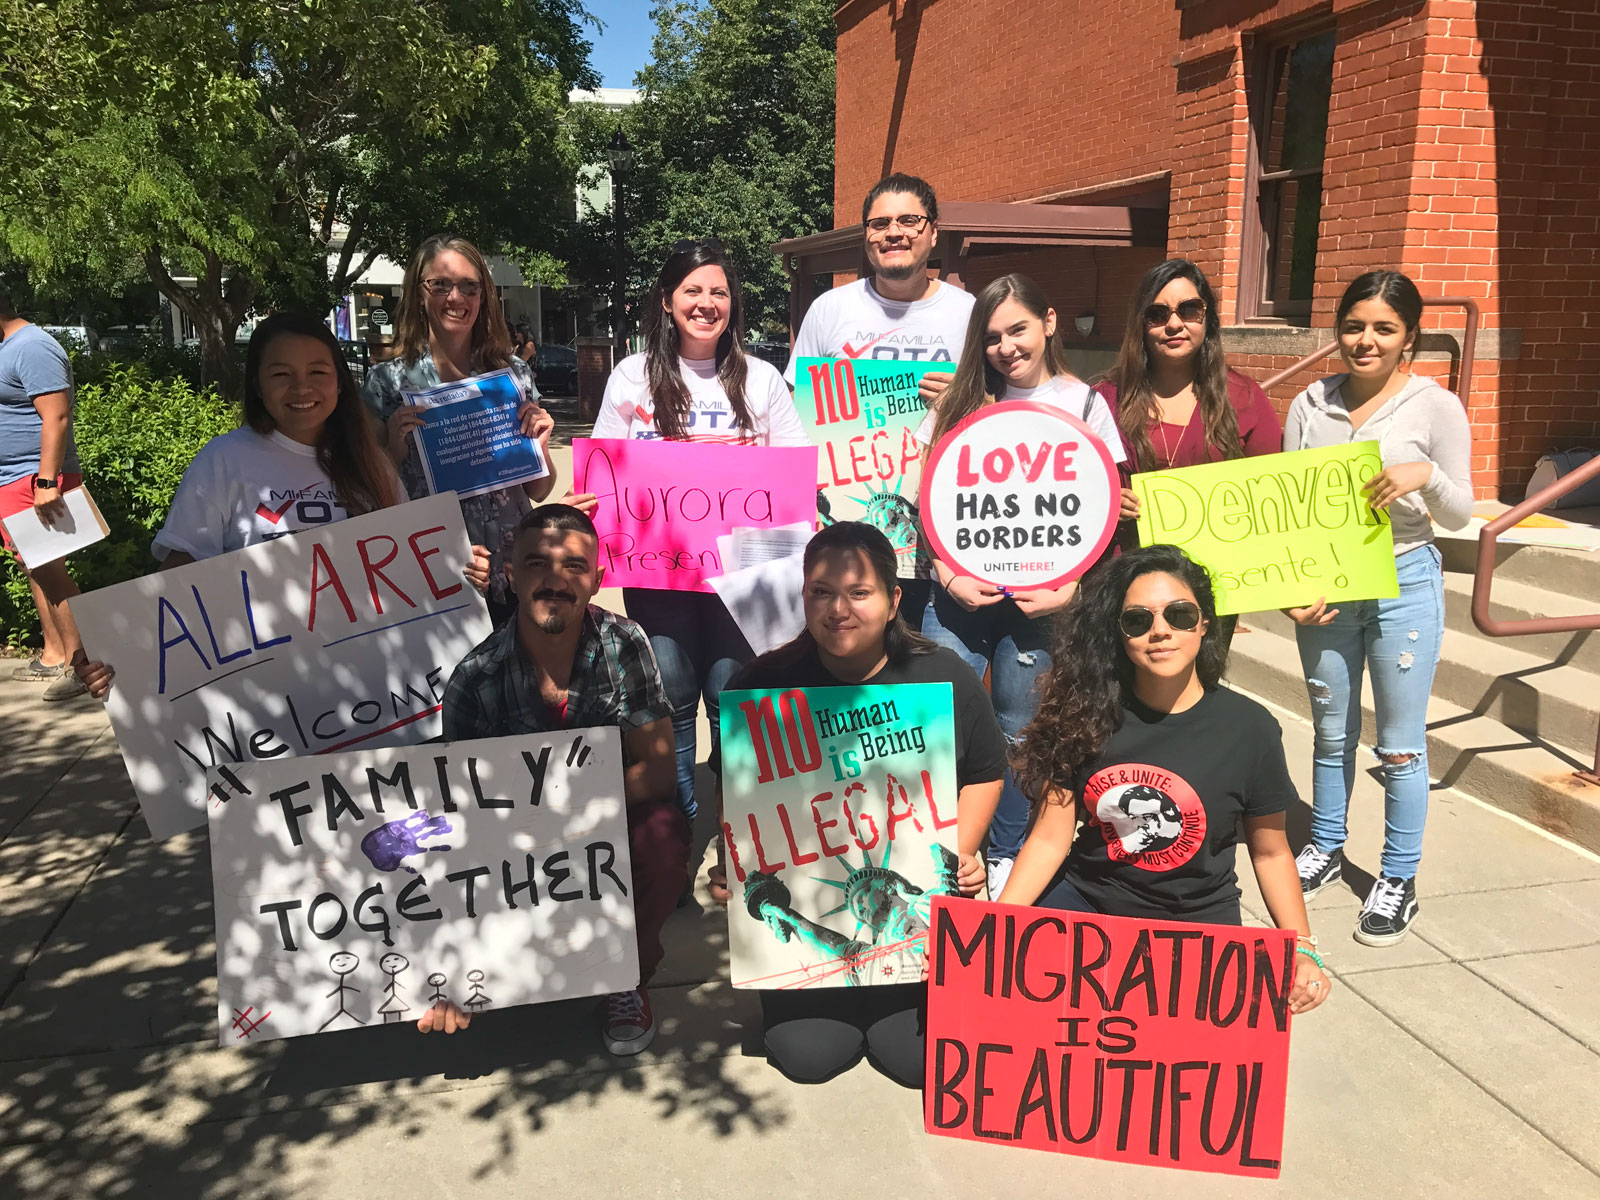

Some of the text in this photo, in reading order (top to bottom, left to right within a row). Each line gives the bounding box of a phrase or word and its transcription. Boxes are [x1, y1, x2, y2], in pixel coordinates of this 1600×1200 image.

[856, 331, 945, 346] MI FAMILIA
[440, 390, 468, 403] redada?
[857, 372, 917, 397] Human
[450, 415, 460, 424] red
[460, 414, 467, 422] de
[467, 407, 493, 419] respuesta
[510, 401, 517, 409] de
[864, 402, 887, 429] is
[886, 393, 927, 417] Bein
[444, 423, 468, 434] Colorado
[493, 422, 513, 432] reportar
[436, 445, 461, 457] cualquier
[462, 437, 485, 450] actividad
[492, 430, 513, 442] oficiales
[475, 446, 493, 456] alguien
[493, 443, 503, 451] que
[510, 438, 521, 446] sido
[956, 441, 1079, 487] LOVE
[269, 490, 297, 501] MI
[583, 447, 774, 523] Aurora
[956, 492, 1081, 520] HAS NO
[956, 524, 1082, 550] BORDERS
[598, 532, 719, 574] Presen
[983, 561, 1054, 572] UNITEHERE!
[158, 525, 463, 694] ALL ARE
[815, 699, 900, 739] Human
[857, 726, 927, 762] Being
[828, 745, 862, 782] is
[1092, 769, 1172, 797] RISE & UNITE:
[723, 769, 958, 883] ILLEGAL
[1143, 850, 1174, 866] MUST
[1172, 809, 1201, 858] CONTINUE
[259, 841, 628, 952] TOGETHER
[935, 907, 1296, 1032] MIGRATION
[1055, 1016, 1138, 1054] IS
[934, 1038, 1280, 1170] BEAUTIFUL
